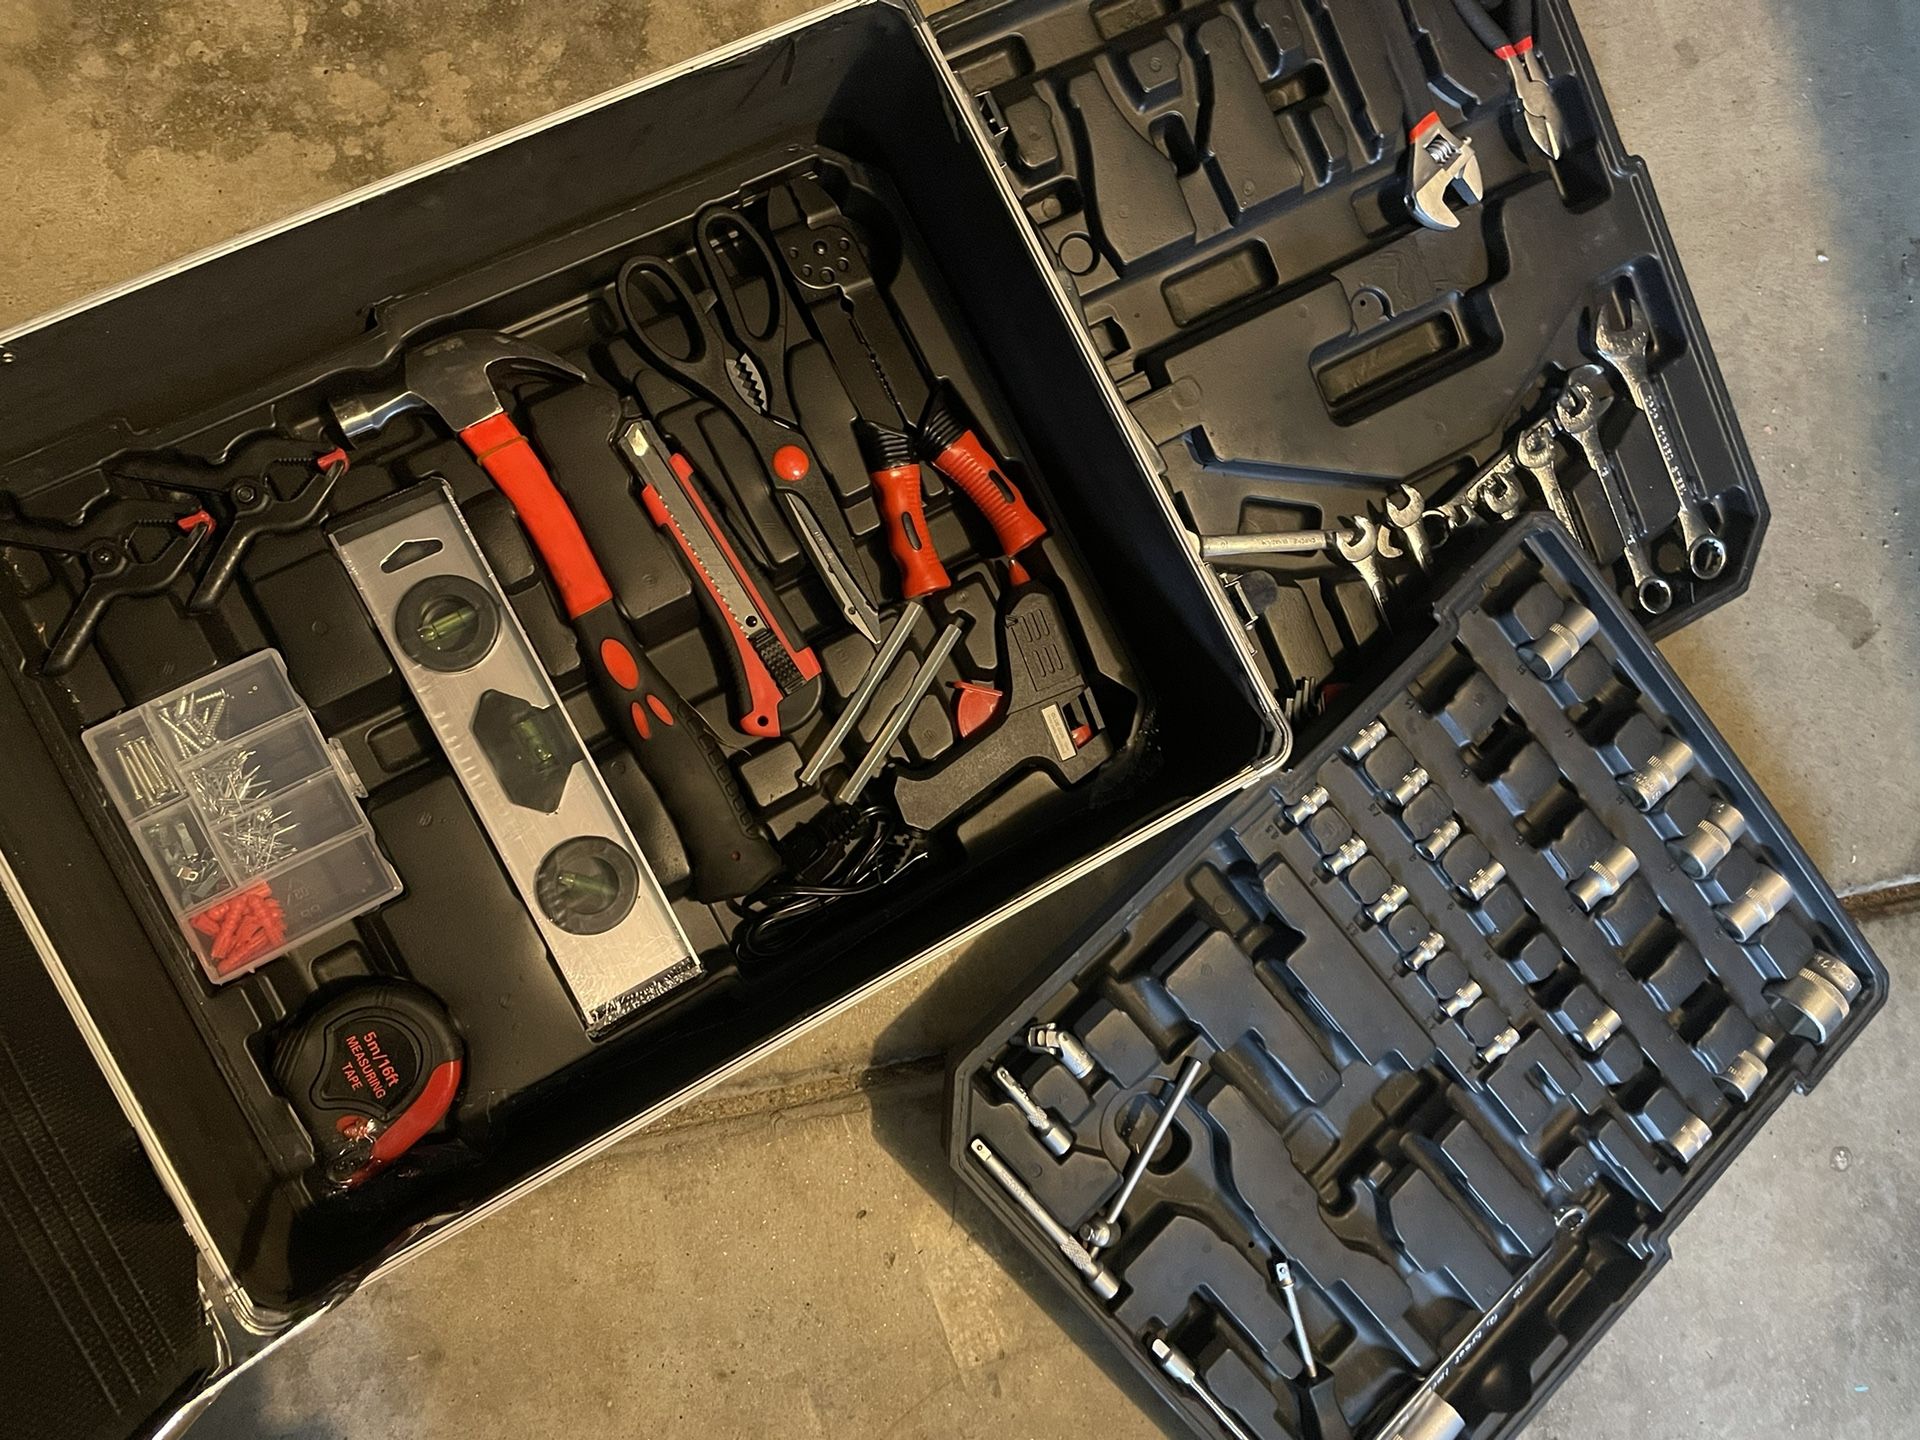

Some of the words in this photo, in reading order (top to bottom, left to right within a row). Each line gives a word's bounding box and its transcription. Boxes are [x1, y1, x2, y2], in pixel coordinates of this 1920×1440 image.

[341, 1061, 363, 1091] TAPE
[346, 1035, 387, 1099] MEASURING
[363, 1031, 399, 1087] 5m/16ft
